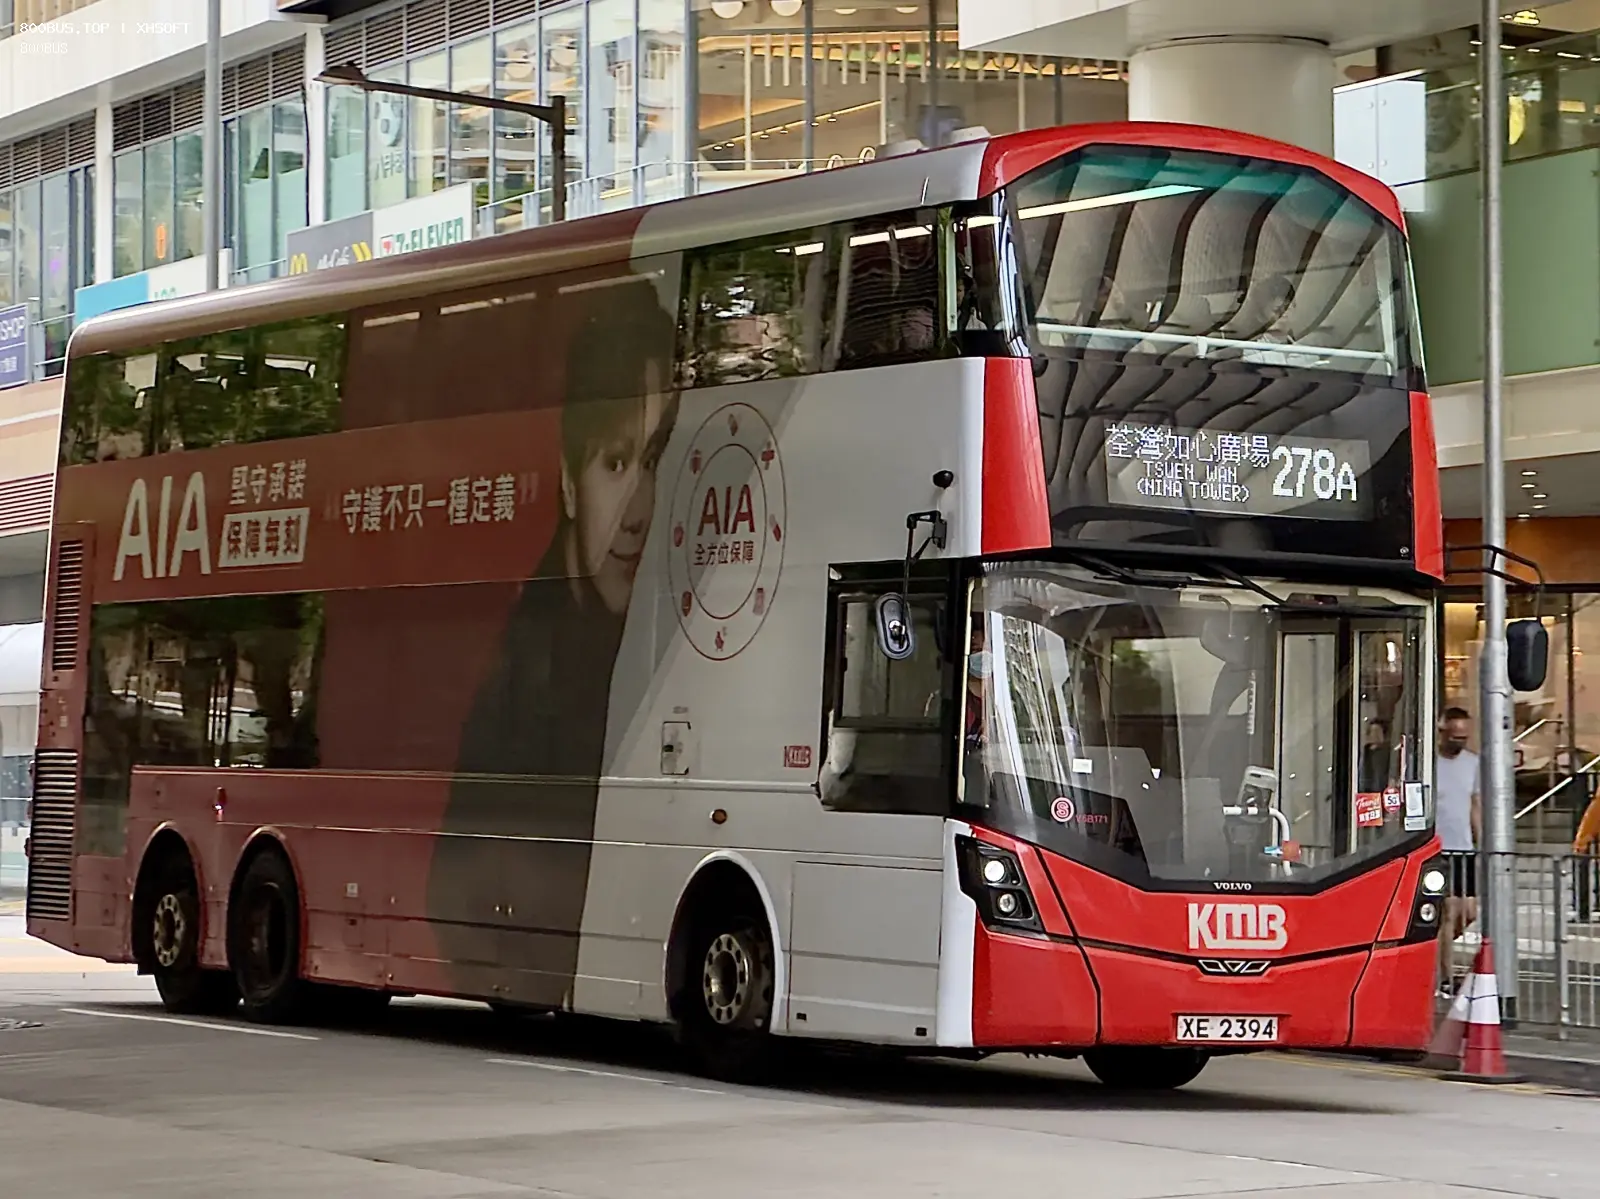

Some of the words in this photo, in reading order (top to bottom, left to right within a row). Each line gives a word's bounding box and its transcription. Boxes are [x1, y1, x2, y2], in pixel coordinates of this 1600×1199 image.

[1106, 423, 1270, 468] 荃灣如心廣場
[229, 459, 306, 504] 堅守承諾
[1137, 478, 1183, 498] (NINA
[1189, 481, 1250, 503] TOWER)
[1143, 460, 1194, 480] TSUEN
[1206, 465, 1237, 483] WAN
[1272, 445, 1357, 501] 278A
[113, 471, 212, 581] AIA
[697, 484, 755, 536] AIA
[227, 515, 301, 559] 保障每刻
[693, 540, 754, 566] 全方位保障
[1213, 882, 1252, 891] VOLVO
[1188, 903, 1288, 950] KMB
[1182, 1018, 1210, 1038] XE
[1219, 1018, 1274, 1039] 2394
